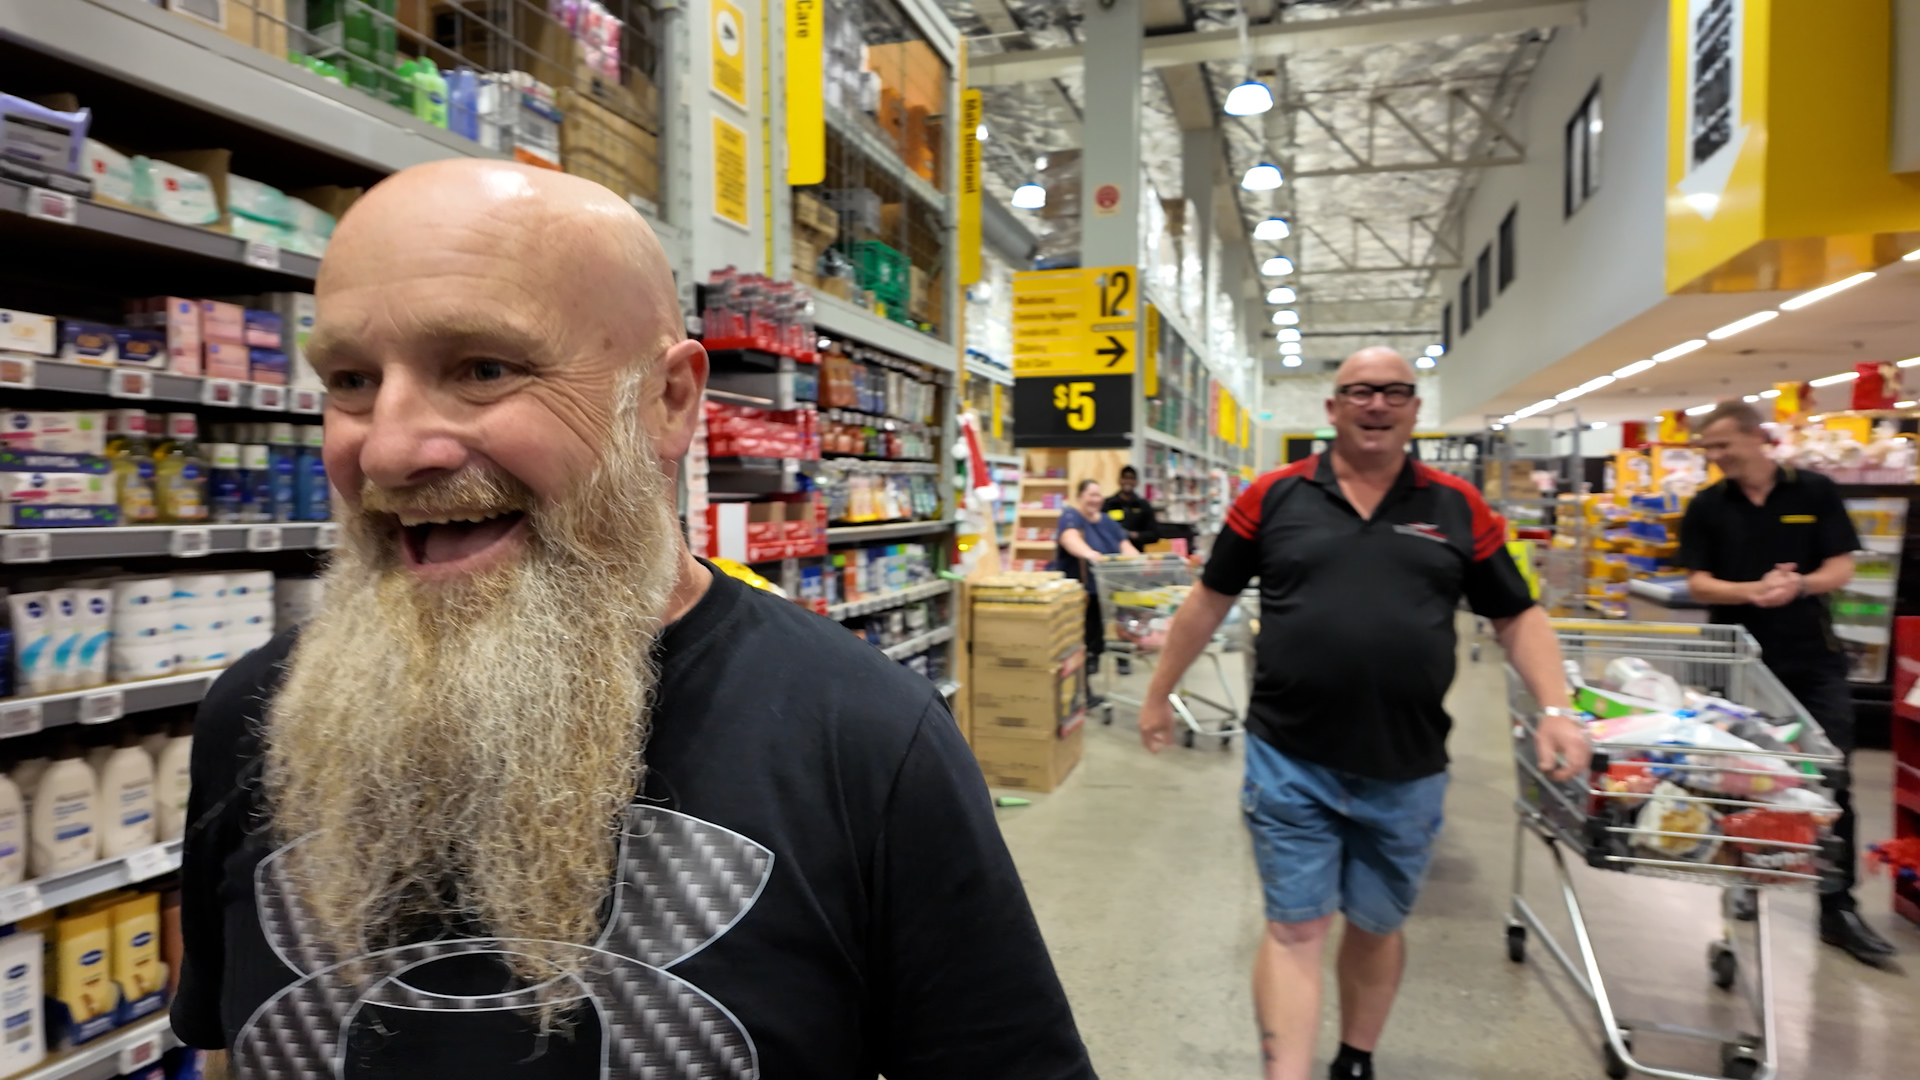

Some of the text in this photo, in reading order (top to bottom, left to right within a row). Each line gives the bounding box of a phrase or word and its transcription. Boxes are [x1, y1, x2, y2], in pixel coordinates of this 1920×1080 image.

[796, 0, 813, 38] Care
[964, 98, 977, 129] Male
[1095, 271, 1130, 318] 12
[1053, 381, 1095, 431] $5
